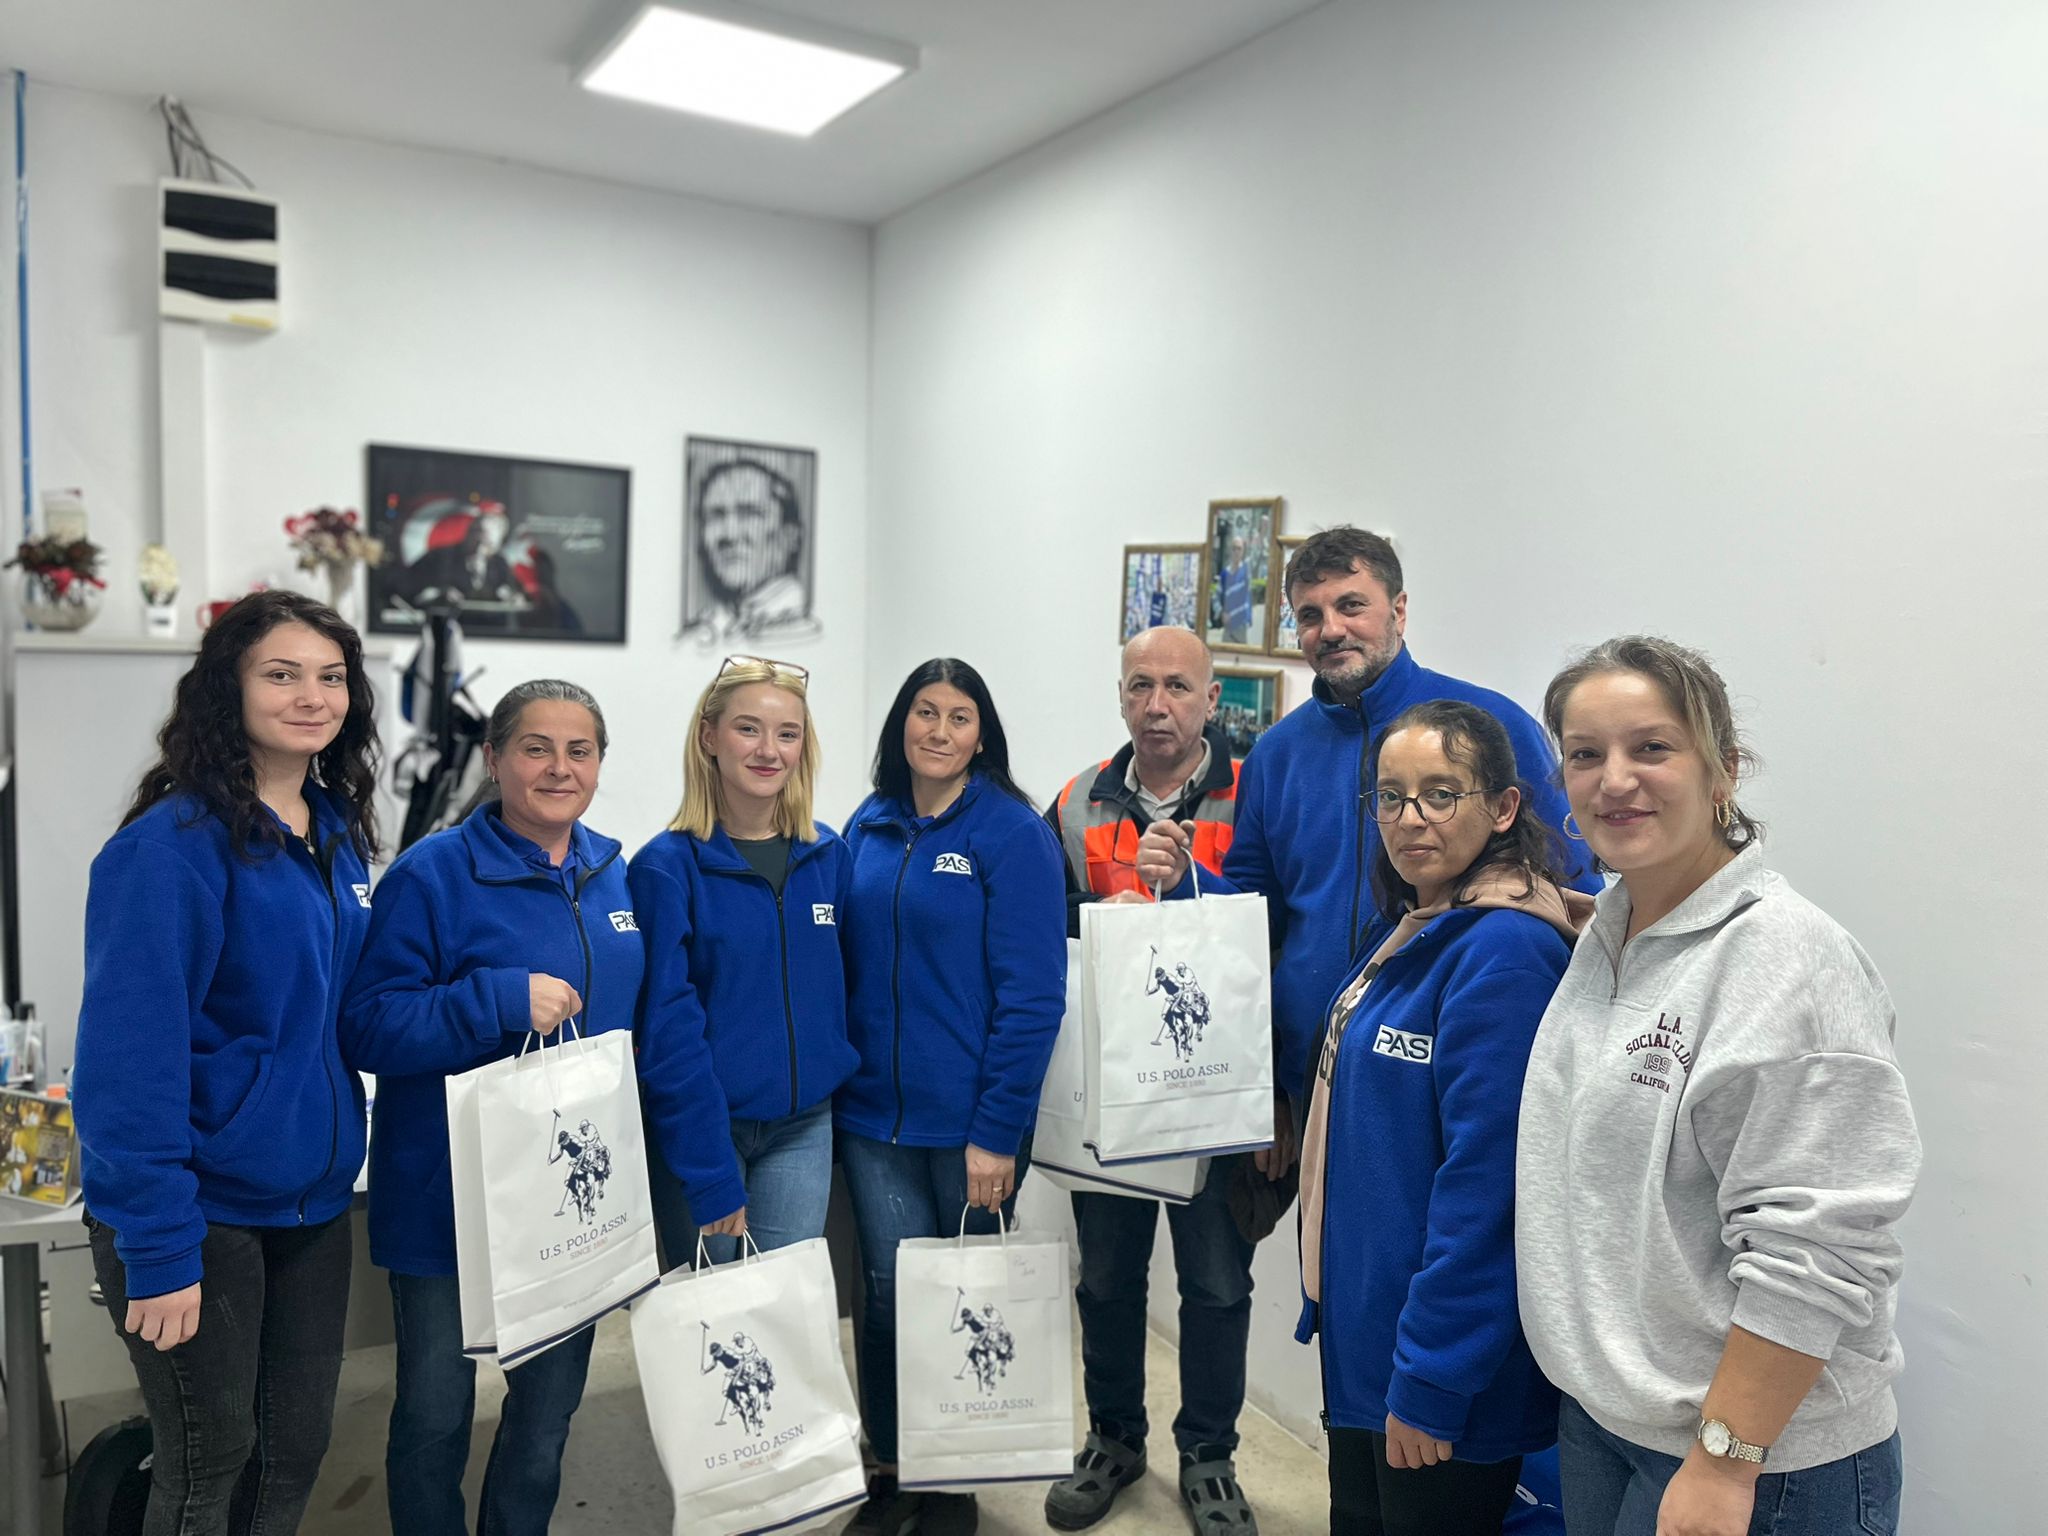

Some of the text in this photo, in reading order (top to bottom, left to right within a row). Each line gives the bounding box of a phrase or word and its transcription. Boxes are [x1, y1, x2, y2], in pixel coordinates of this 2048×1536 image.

[934, 856, 970, 872] PAS
[815, 907, 835, 922] PA
[1656, 1012, 1683, 1036] L.A.
[1376, 1029, 1430, 1060] PAS
[1625, 1033, 1671, 1056] SOCIAL
[1137, 1062, 1233, 1084] U.S. POLO ASSN.
[566, 1228, 599, 1251] POLO
[965, 1400, 998, 1413] POLO
[733, 1440, 770, 1461] POLO
